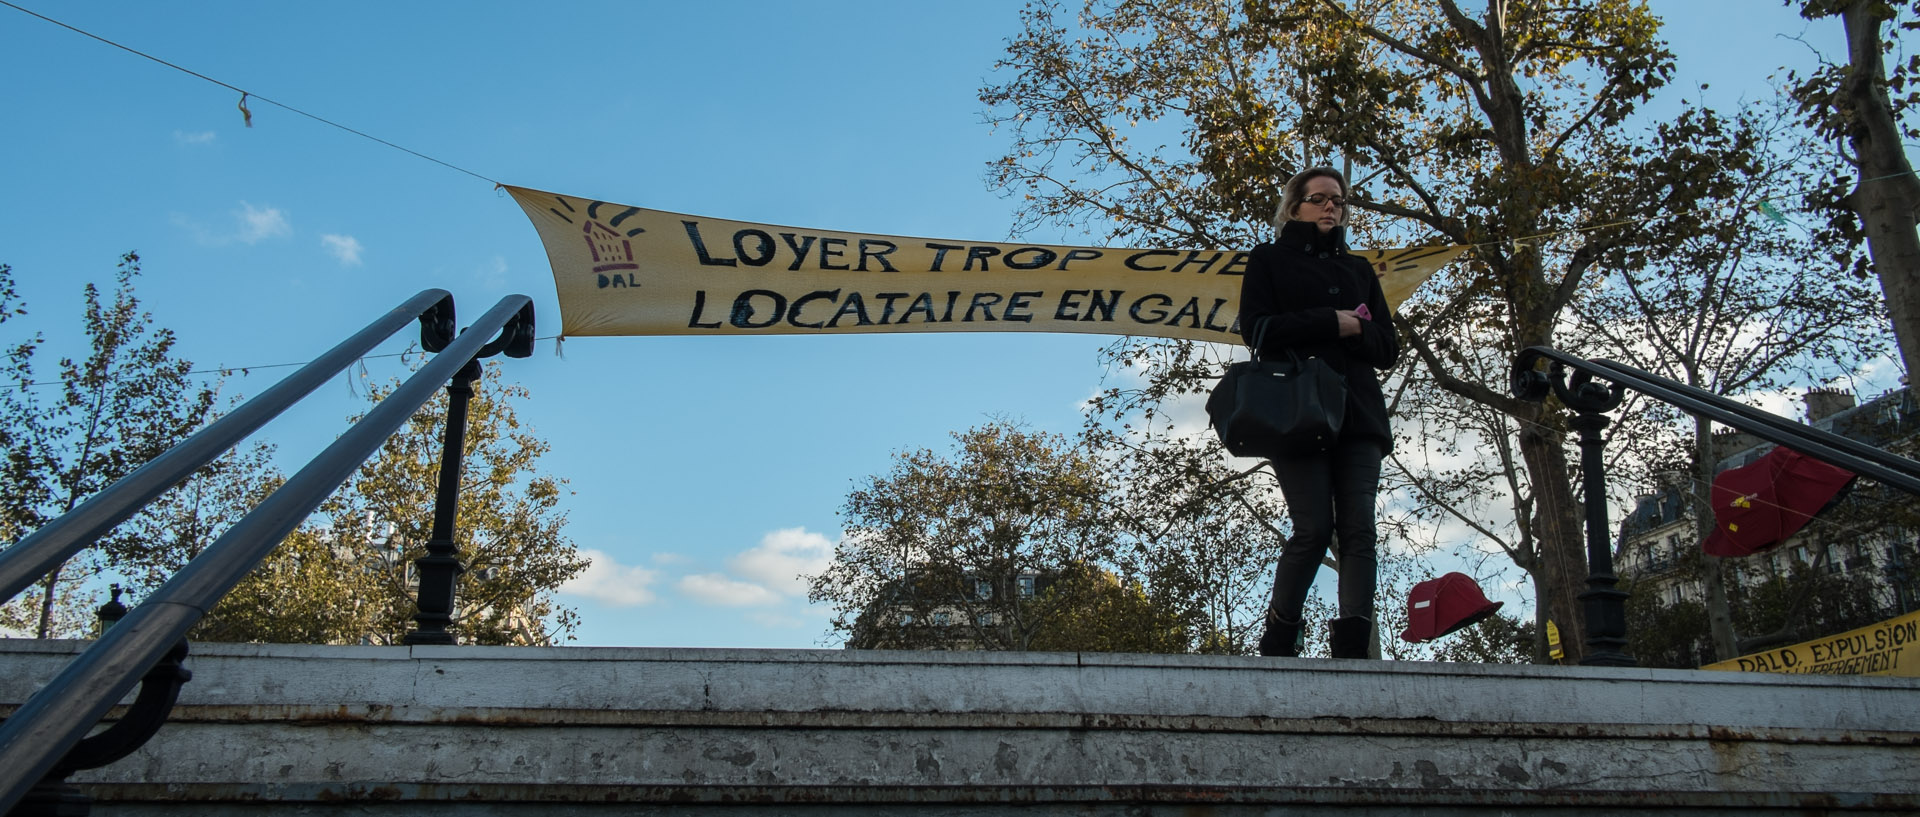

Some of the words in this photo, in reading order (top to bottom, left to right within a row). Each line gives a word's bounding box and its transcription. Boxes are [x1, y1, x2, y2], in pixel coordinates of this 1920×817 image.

[681, 220, 900, 273] LOYER
[925, 242, 1104, 272] TROP
[1124, 249, 1249, 276] CHE
[598, 273, 641, 288] DAL
[688, 288, 1044, 330] LOCATAIRE
[1053, 289, 1126, 322] EN
[1128, 293, 1241, 336] GAL
[1810, 620, 1918, 663] EXPULSION
